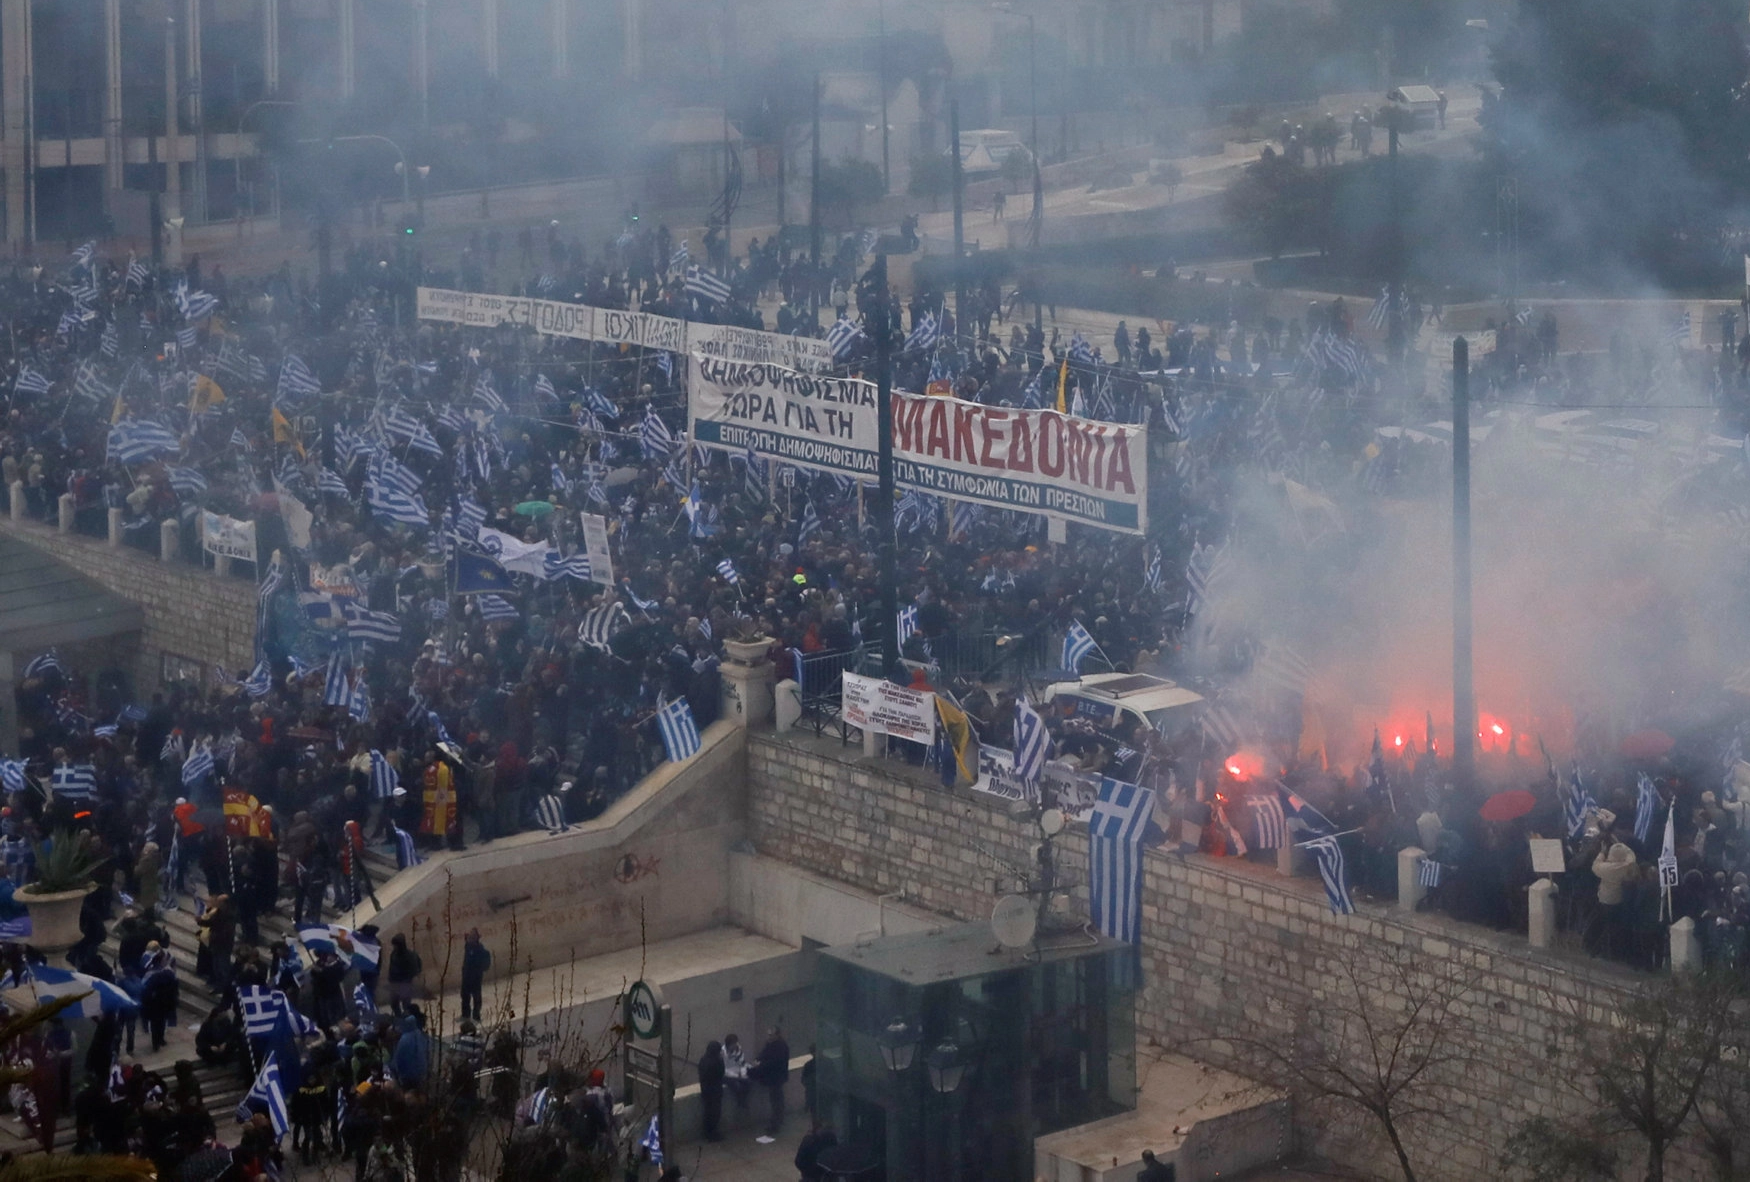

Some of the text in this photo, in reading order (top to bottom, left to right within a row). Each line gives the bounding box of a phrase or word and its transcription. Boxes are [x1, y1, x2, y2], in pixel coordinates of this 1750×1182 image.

[700, 356, 876, 409] ΔΗΜΟΨΗΦΙΣΜΑ
[722, 392, 854, 440] ΤΩΡΑ ΓΙΑ ΤΗ
[890, 392, 1136, 495] ΜΑΚΕΔΟΝΙΑ
[719, 425, 777, 449] ΕΠΙΤΡΟΠΗ
[897, 464, 917, 483] ΓΙΑ
[918, 468, 935, 486] ΤΗ
[937, 470, 1009, 500] ΣΥΜΦΩΝΙΑ
[1012, 482, 1040, 505] ΤΩΝ
[1046, 488, 1106, 520] ΠΡΕΣΠΩΝ
[1661, 866, 1677, 886] 15
